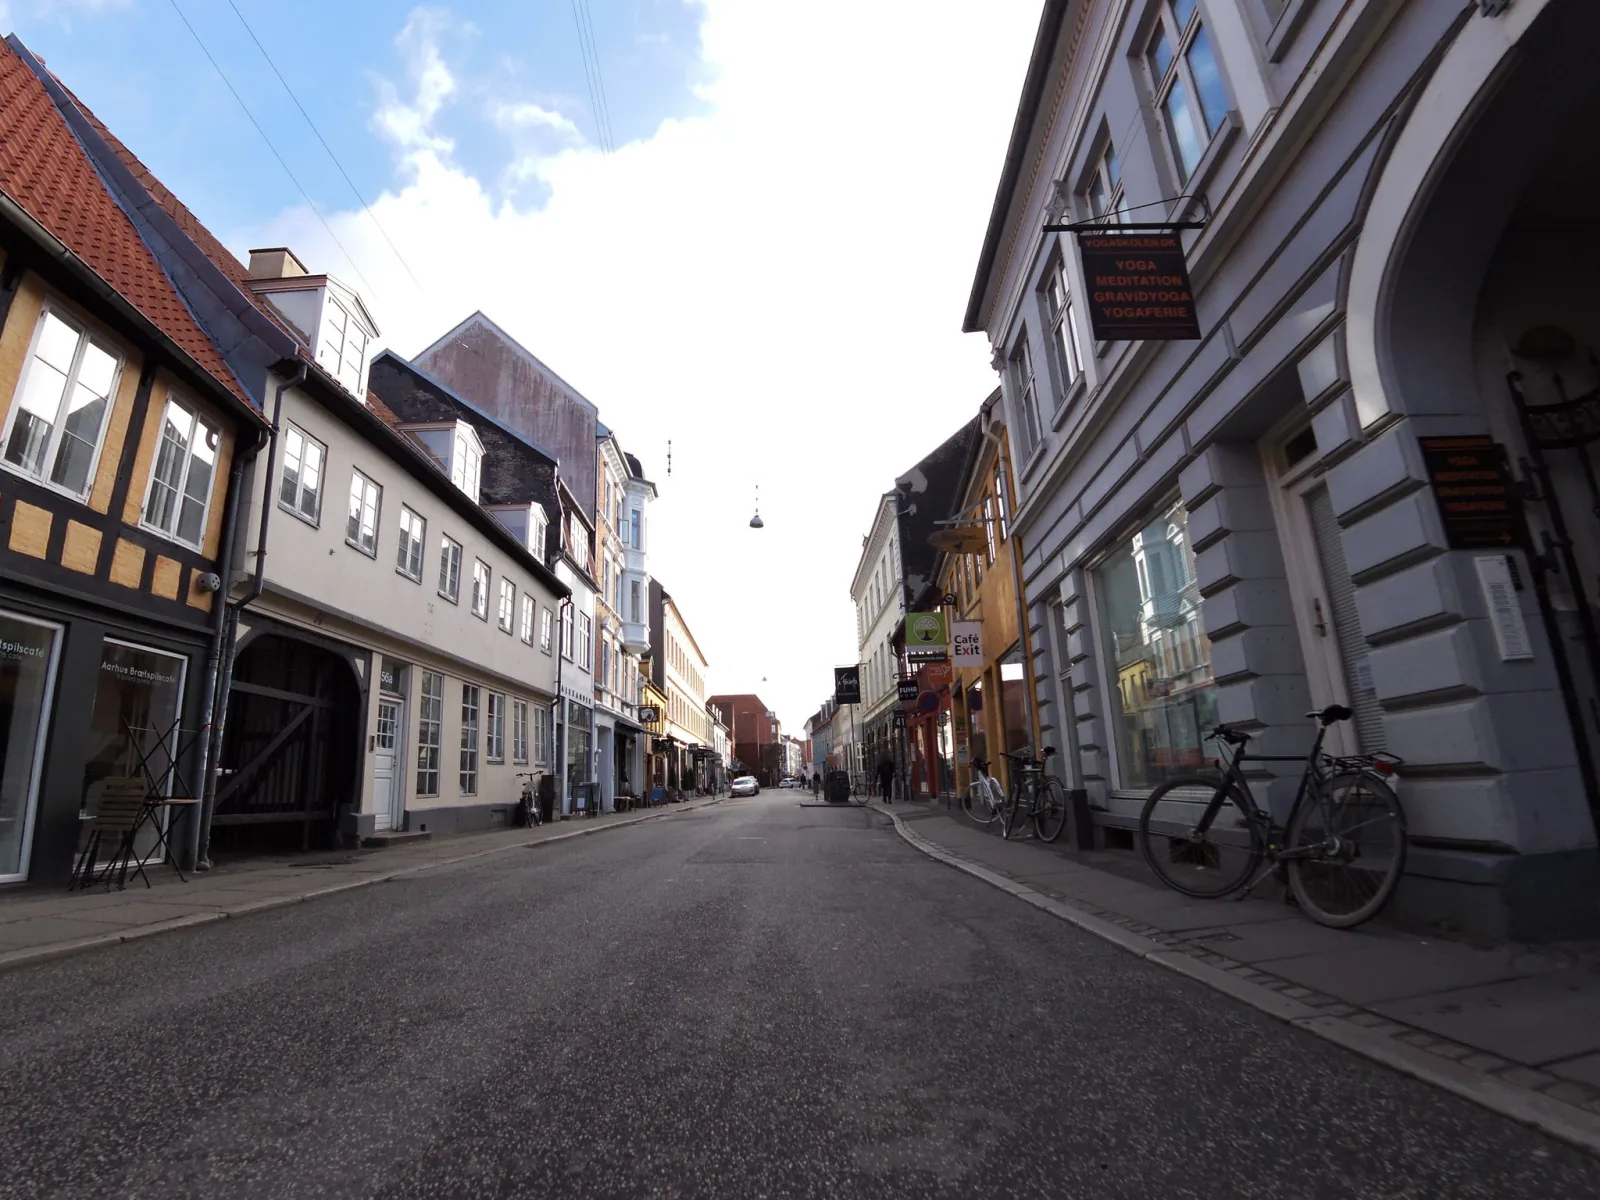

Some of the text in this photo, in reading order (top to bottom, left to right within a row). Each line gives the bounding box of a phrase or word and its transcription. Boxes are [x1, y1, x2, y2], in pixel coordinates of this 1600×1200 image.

[1116, 261, 1156, 270] YOGA
[1095, 275, 1182, 286] MEDITATION
[1095, 292, 1189, 301] GRAVIDYOGA
[1103, 308, 1187, 317] YOGAFERIE
[954, 634, 979, 644] Café
[955, 645, 980, 656] Exit
[101, 660, 129, 674] Aarhus
[381, 671, 393, 684] 56a
[896, 717, 905, 726] 41
